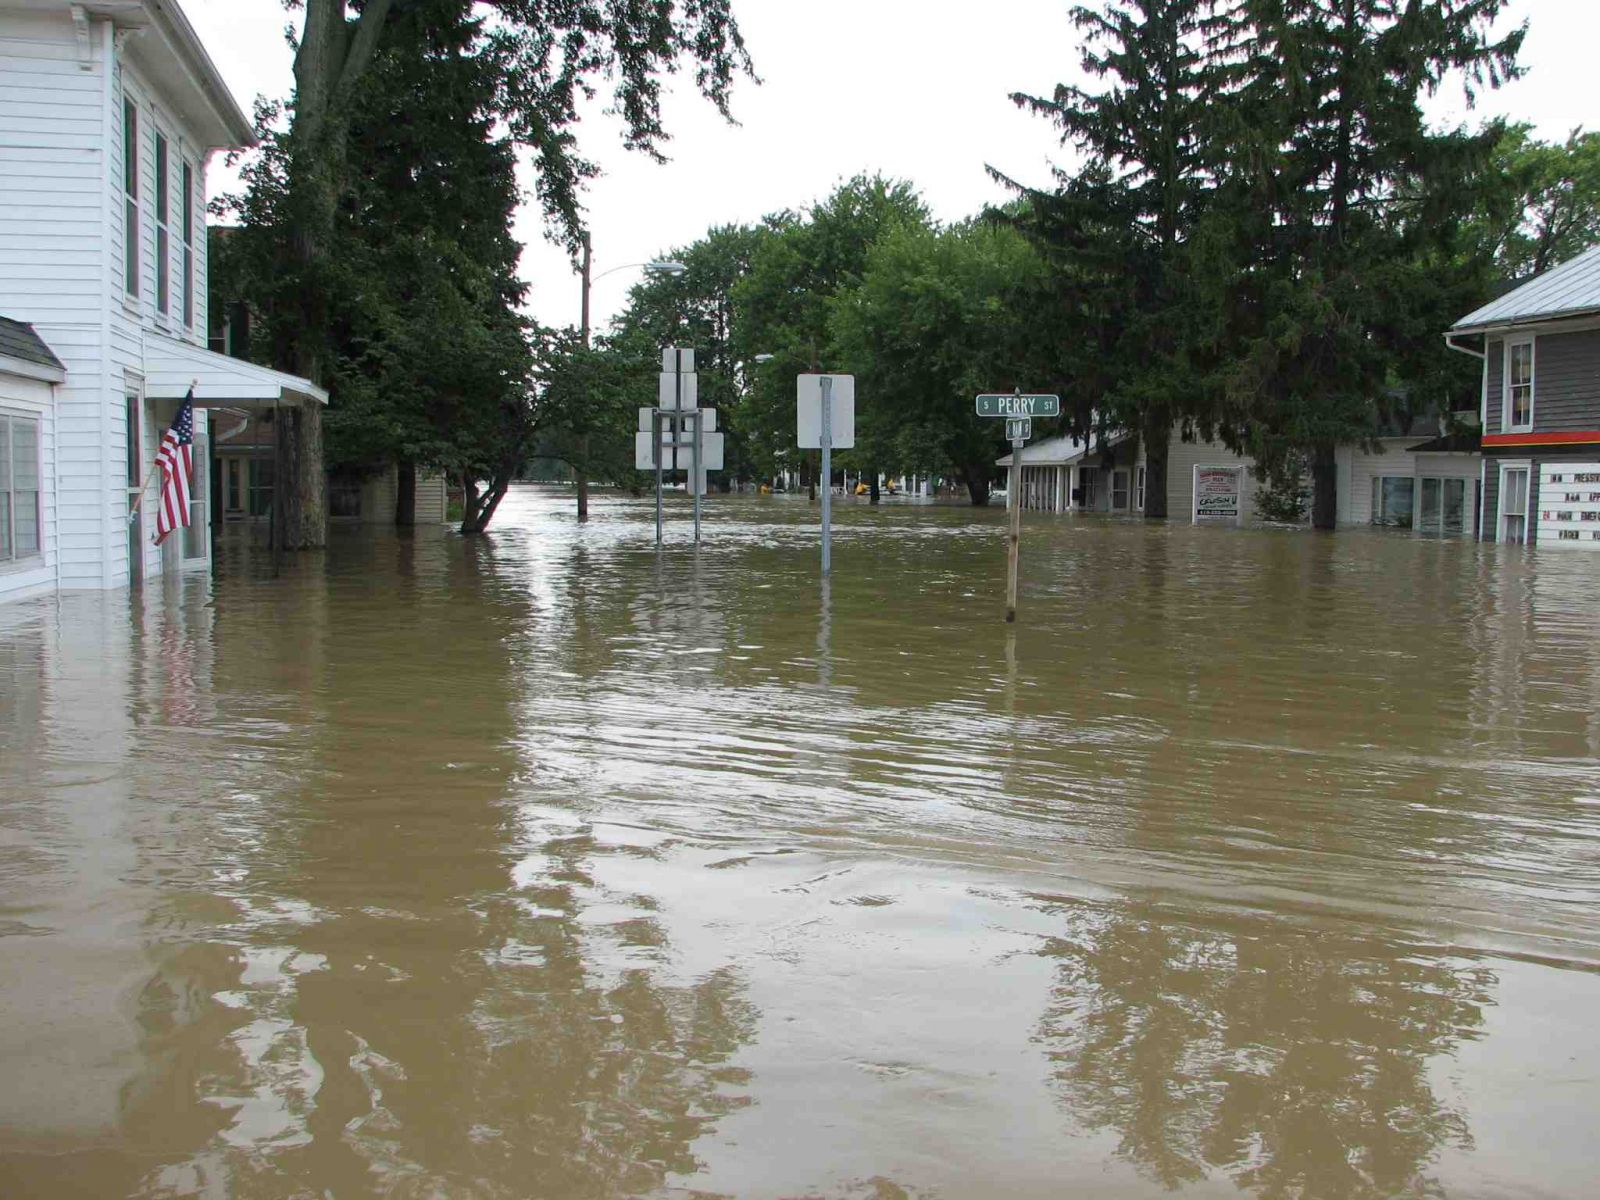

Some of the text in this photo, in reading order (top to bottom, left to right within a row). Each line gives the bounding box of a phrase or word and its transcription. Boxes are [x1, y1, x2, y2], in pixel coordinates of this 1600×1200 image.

[984, 397, 1053, 414] S PERRY ST
